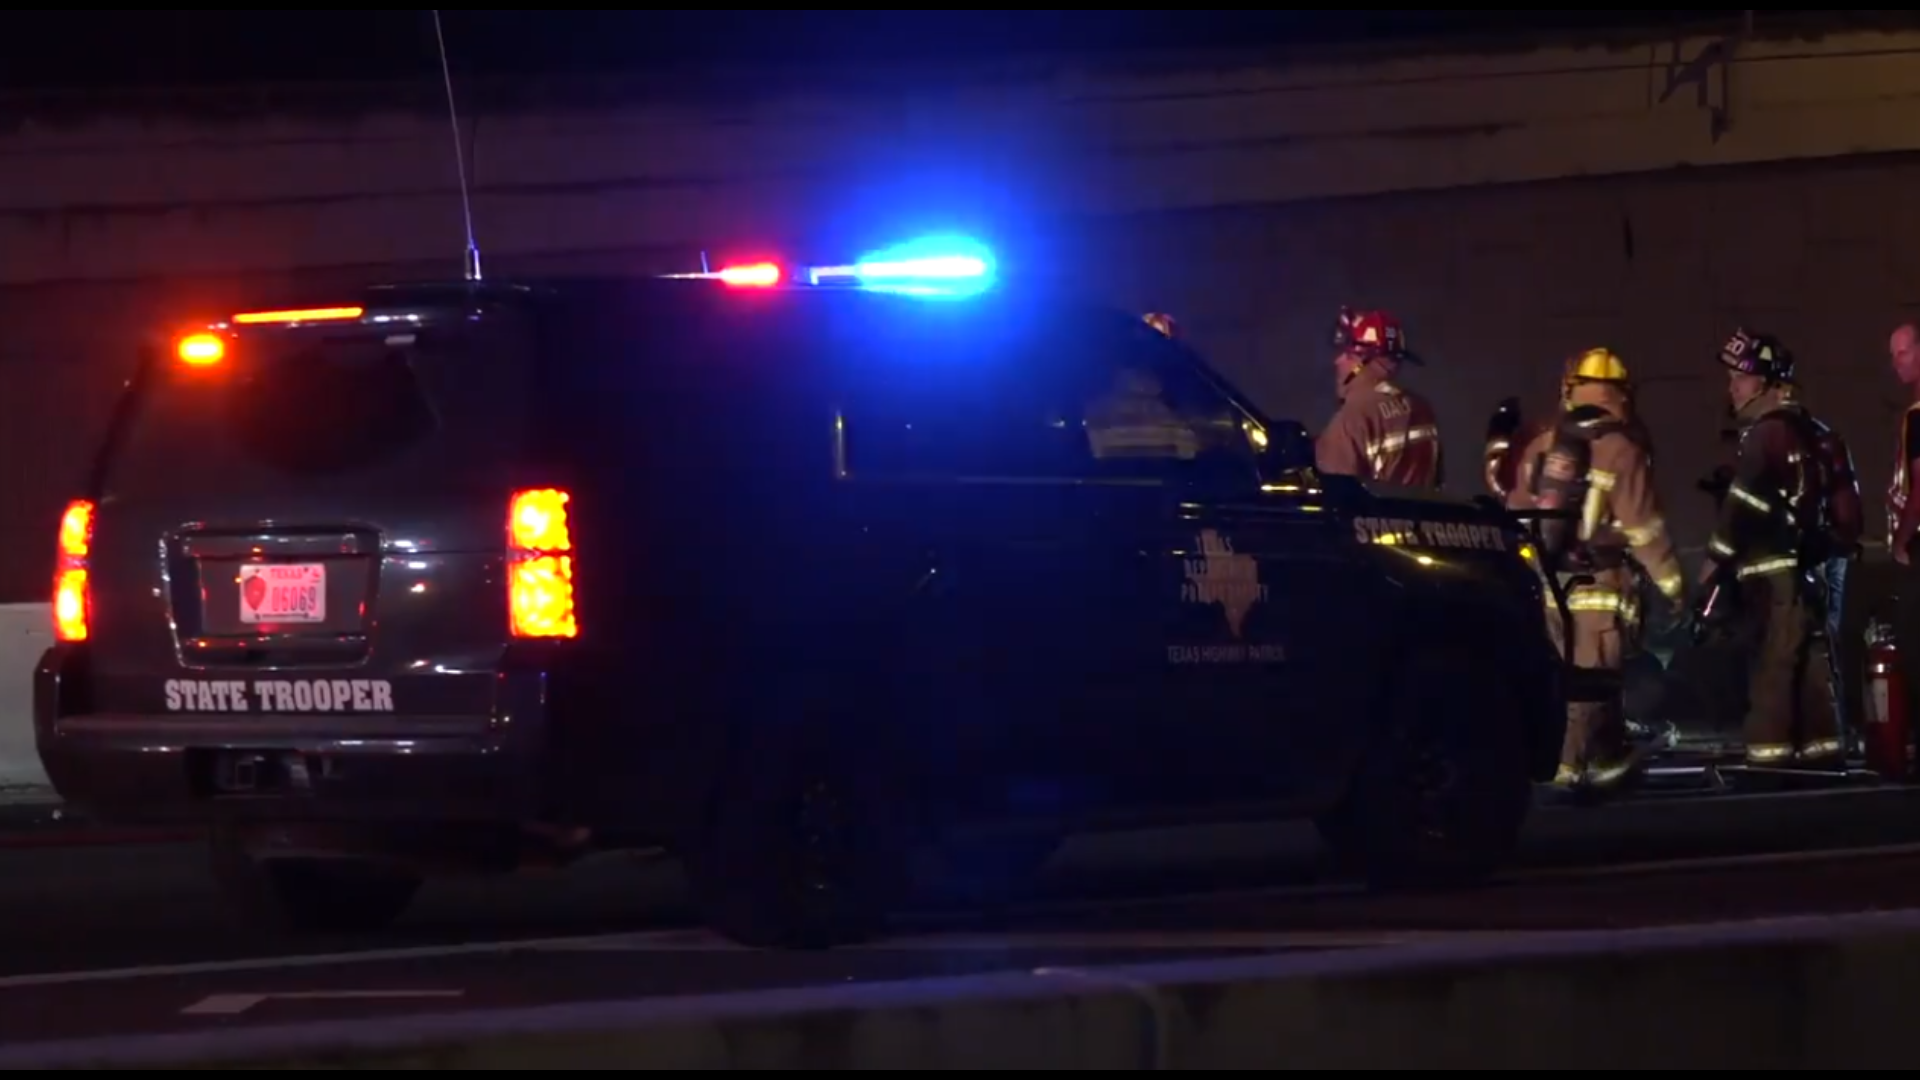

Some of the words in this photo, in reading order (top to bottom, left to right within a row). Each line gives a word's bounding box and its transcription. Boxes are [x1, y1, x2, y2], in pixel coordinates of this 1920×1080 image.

[1353, 515, 1419, 546] STATE
[1420, 520, 1507, 552] TROOPER
[270, 568, 304, 580] TEXAS
[271, 586, 317, 612] 06069
[1167, 645, 1199, 664] TEXAS
[1201, 645, 1245, 663] HIGHWAY
[1248, 645, 1287, 662] PATROL
[164, 679, 250, 712] STATE
[254, 679, 394, 712] TROOPER
